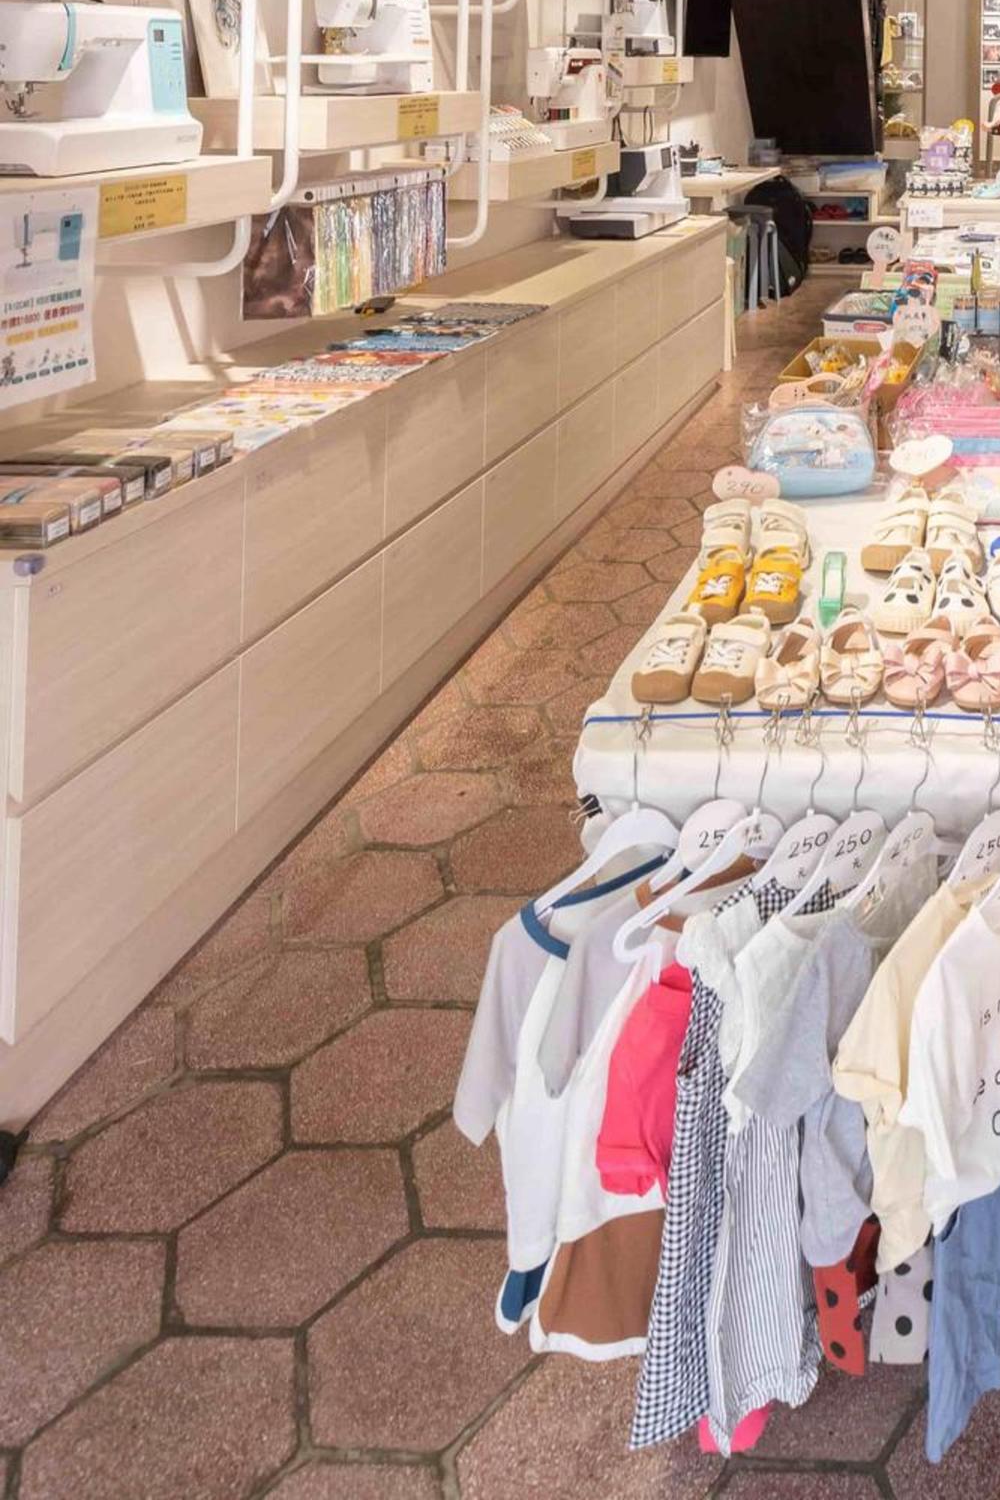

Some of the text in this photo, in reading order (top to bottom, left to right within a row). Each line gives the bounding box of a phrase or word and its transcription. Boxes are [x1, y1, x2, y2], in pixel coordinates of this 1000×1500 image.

[698, 829, 727, 849] 25
[788, 831, 829, 859] 250
[835, 828, 872, 858] 250
[890, 827, 924, 860] 250
